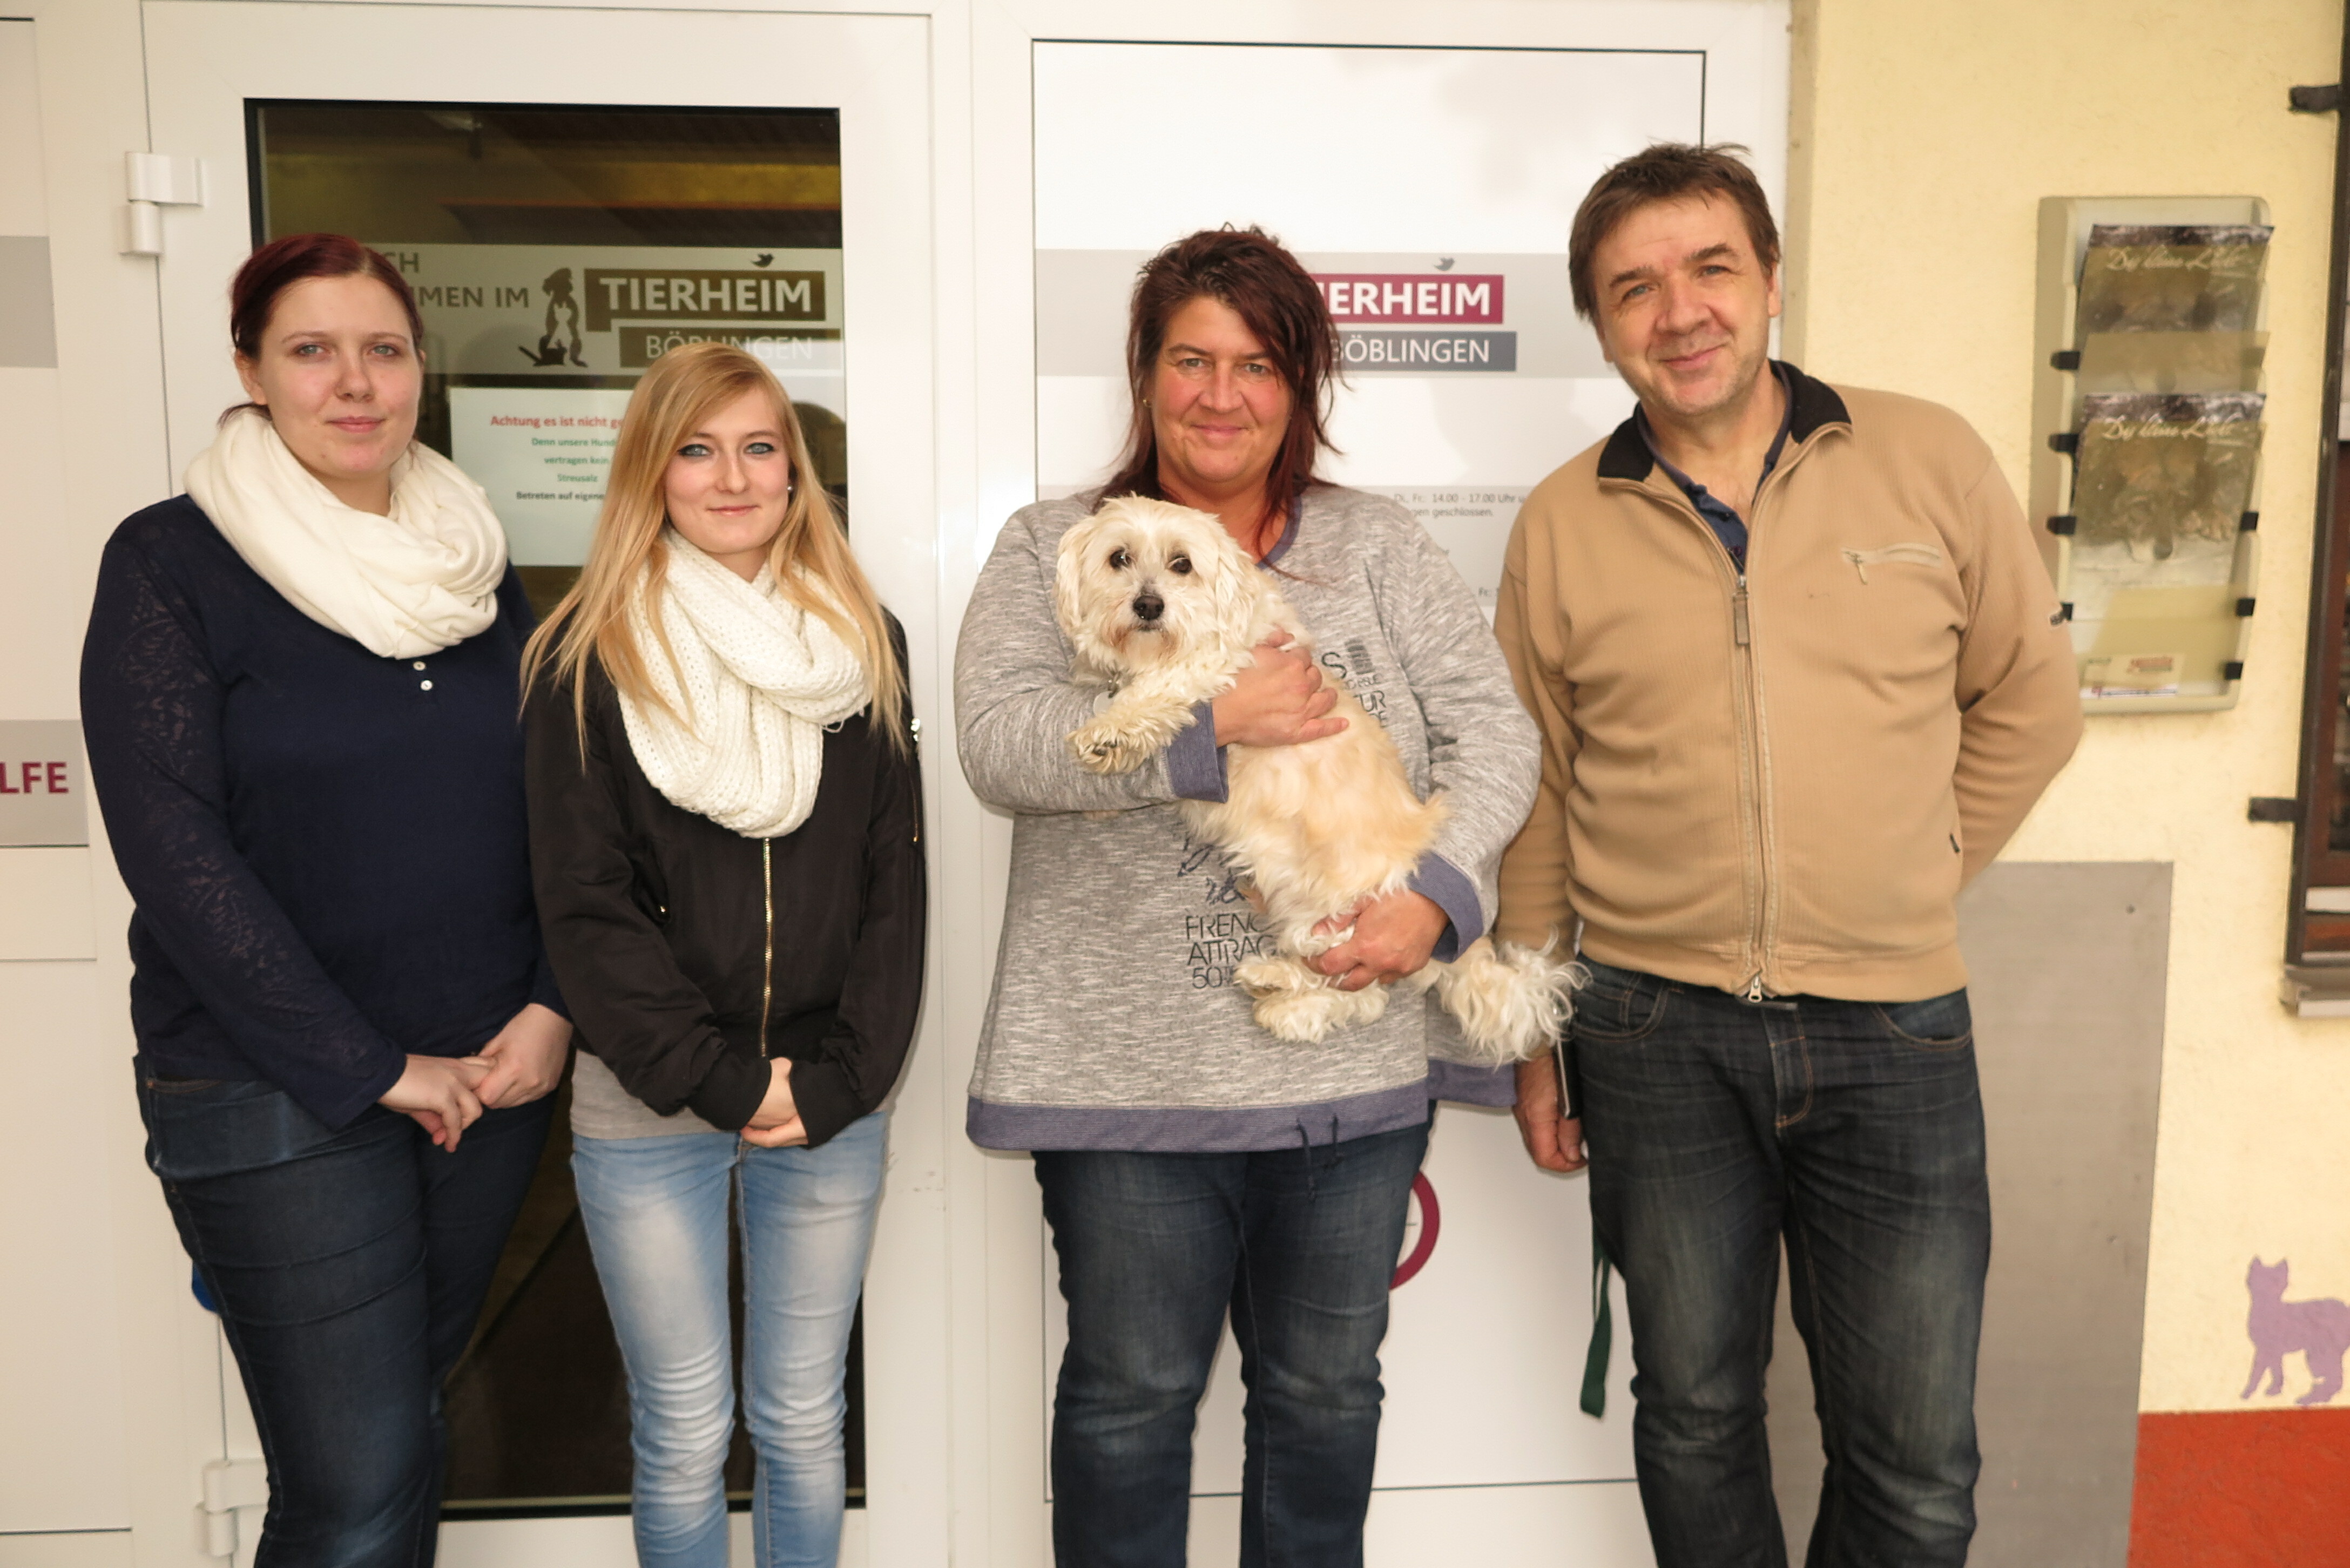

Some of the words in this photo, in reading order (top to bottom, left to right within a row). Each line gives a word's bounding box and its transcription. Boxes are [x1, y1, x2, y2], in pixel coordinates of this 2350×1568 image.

[495, 287, 529, 308] IM
[599, 278, 811, 312] TIERHEIM
[490, 416, 541, 428] Achtung
[544, 418, 557, 427] es
[560, 417, 574, 427] ist
[577, 416, 607, 427] nicht
[531, 437, 555, 446] Denn
[557, 474, 598, 482] Streusalz
[516, 491, 556, 500] Betreten
[557, 491, 572, 499] auf
[1497, 493, 1515, 503] Uhr
